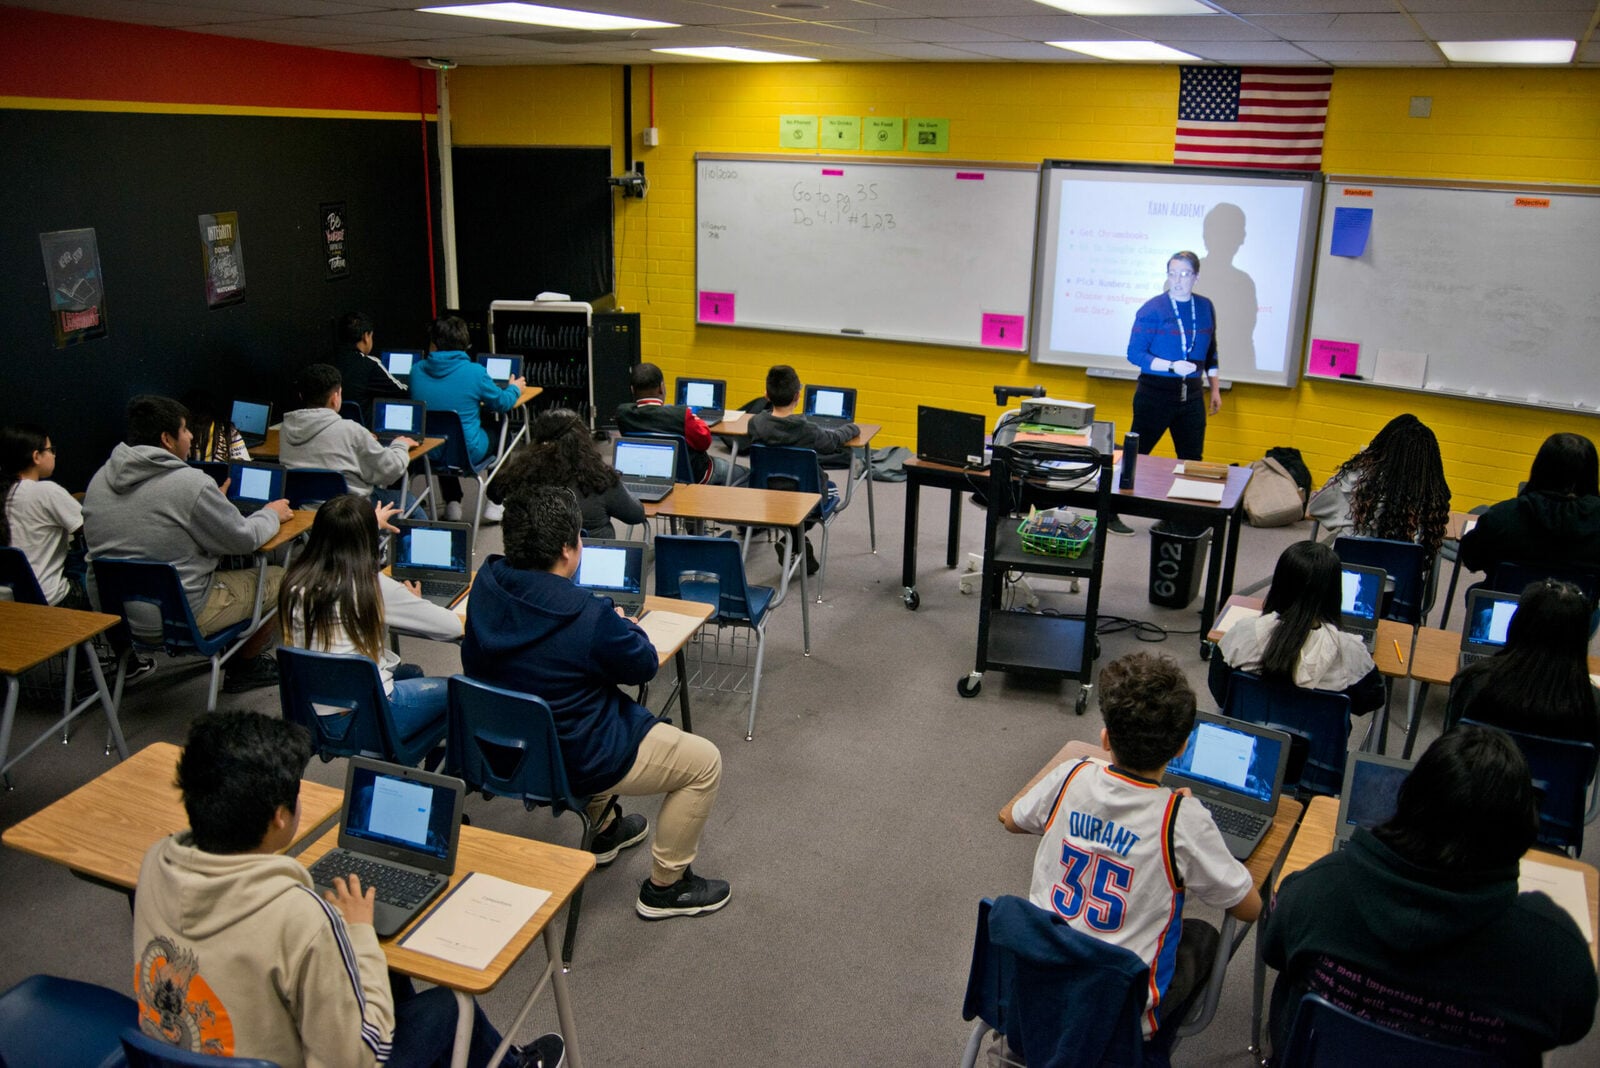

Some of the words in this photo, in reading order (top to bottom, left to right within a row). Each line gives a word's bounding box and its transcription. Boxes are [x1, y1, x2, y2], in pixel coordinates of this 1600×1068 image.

[792, 181, 811, 201] Go
[816, 183, 831, 203] to
[856, 182, 879, 201] 35
[207, 223, 233, 241] INTEGRITY
[793, 207, 813, 226] Do
[1154, 542, 1182, 598] 602
[1069, 811, 1140, 857] DURANT
[1051, 838, 1134, 933] 35
[1332, 997, 1353, 1012] you
[1356, 1008, 1371, 1021] do
[1337, 964, 1362, 983] most
[1445, 1004, 1464, 1018] the
[1337, 984, 1358, 999] you
[1363, 997, 1385, 1010] will
[1440, 1024, 1463, 1033] will
